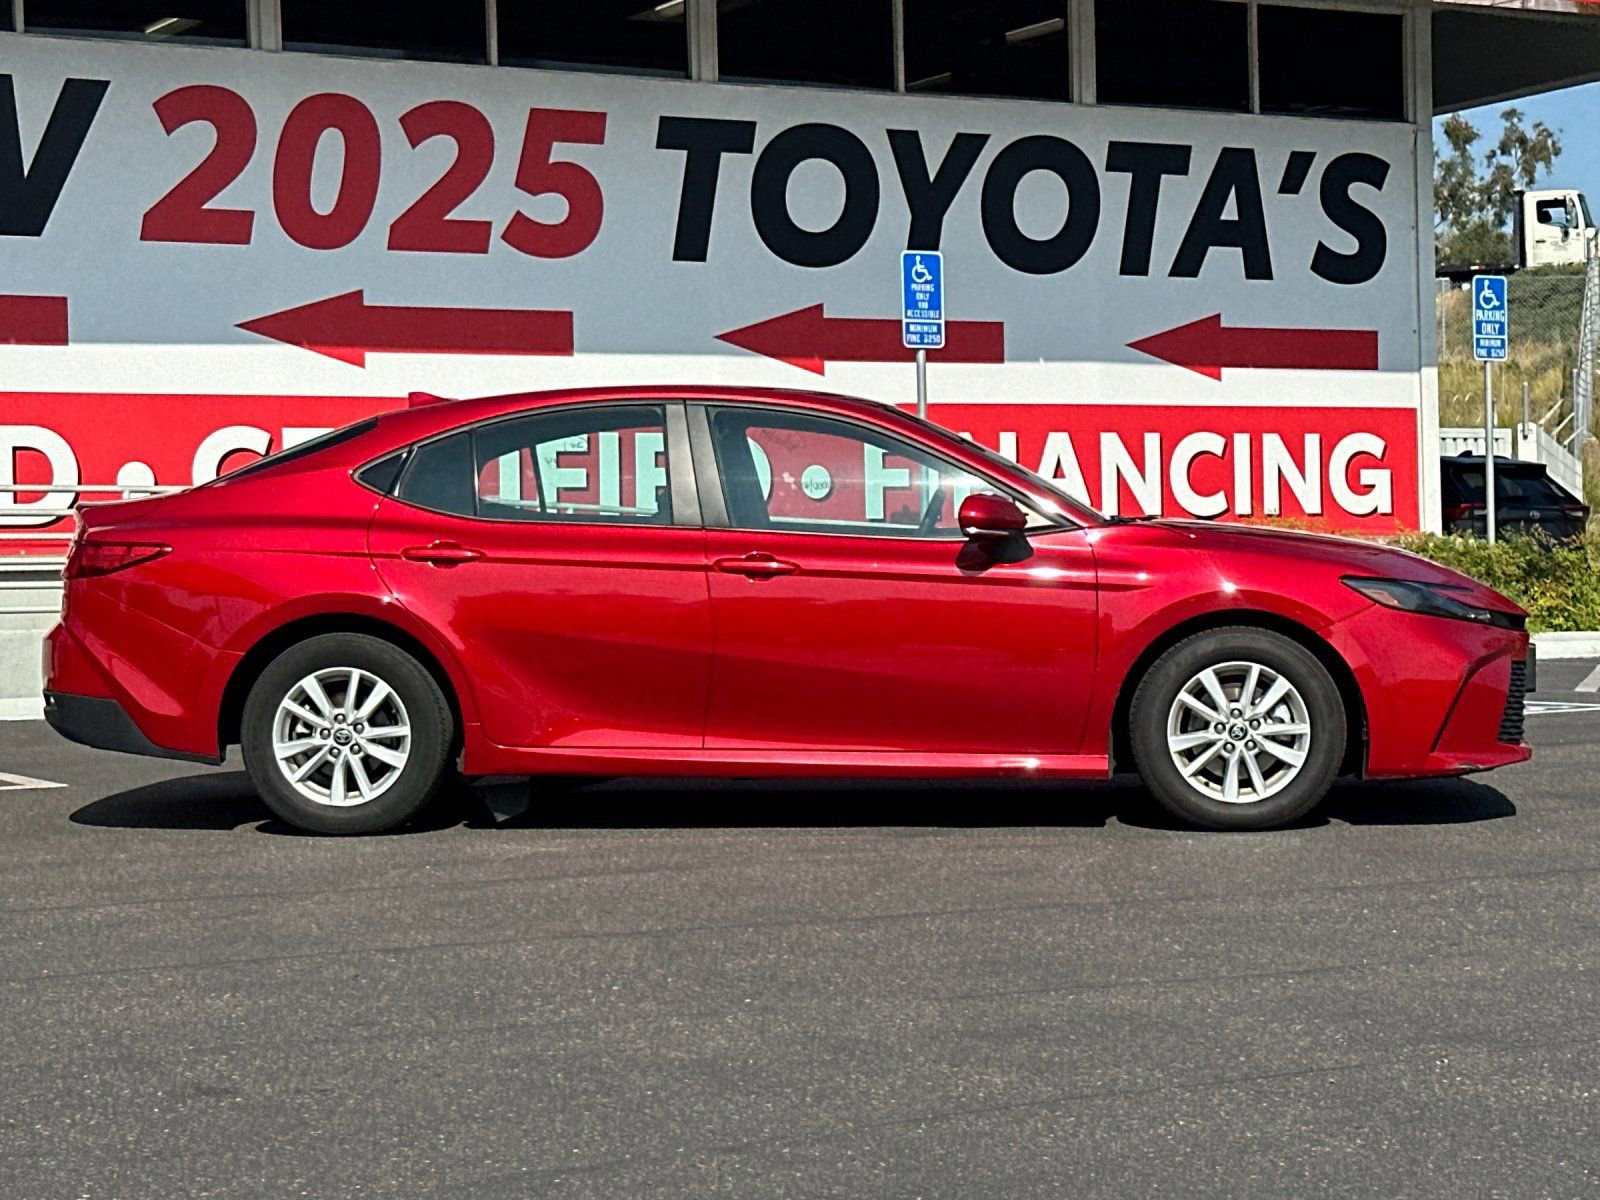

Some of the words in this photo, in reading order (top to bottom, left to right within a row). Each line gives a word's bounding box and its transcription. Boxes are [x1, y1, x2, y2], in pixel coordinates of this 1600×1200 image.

[140, 84, 608, 259] 2025
[655, 115, 1391, 285] TOYOTA'S
[915, 292, 930, 301] ONLY
[906, 309, 940, 319] ACCESSIBLE
[1475, 309, 1505, 322] PARKING
[909, 323, 938, 333] MINIMUM
[1481, 322, 1500, 335] ONLY
[906, 333, 921, 343] FINE
